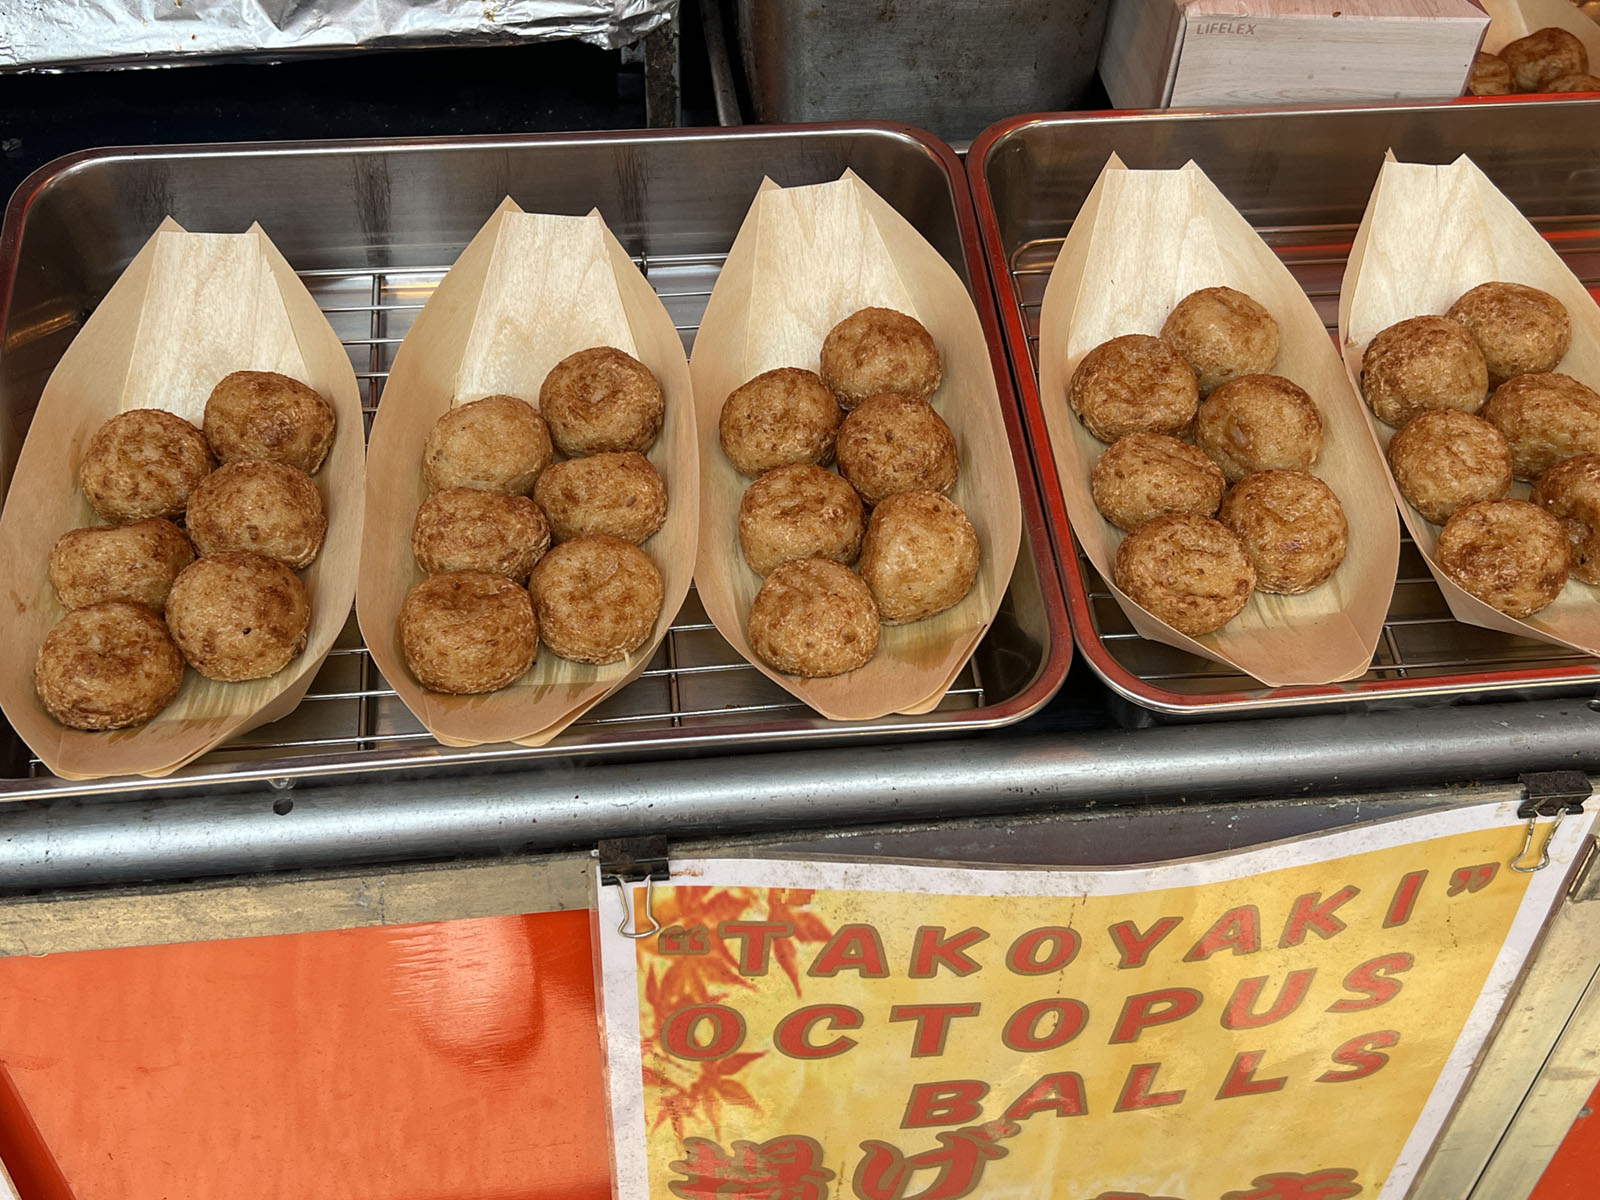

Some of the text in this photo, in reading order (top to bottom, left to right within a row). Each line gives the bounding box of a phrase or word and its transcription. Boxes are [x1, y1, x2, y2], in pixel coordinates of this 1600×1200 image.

[1196, 22, 1256, 35] LIFELEX
[660, 952, 1415, 1062] OCTOPUS
[899, 1030, 1401, 1130] BALLS
